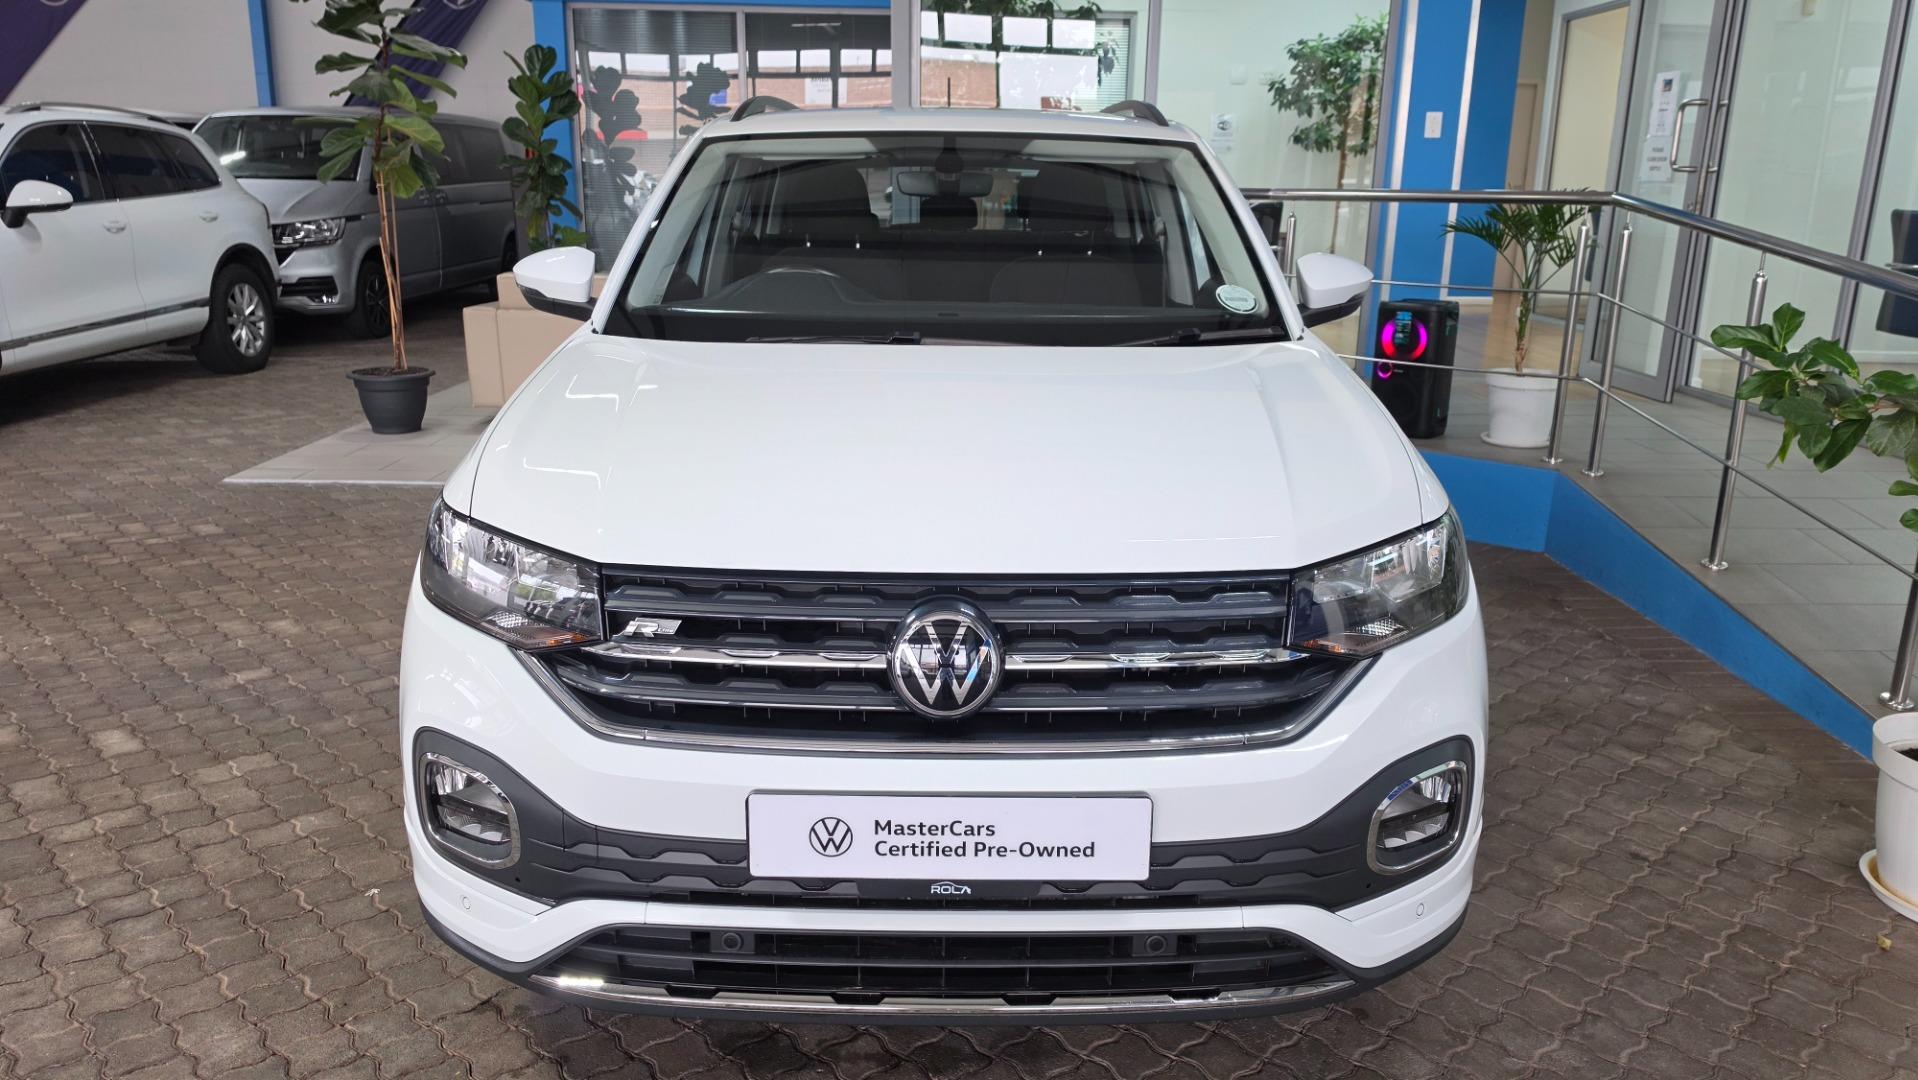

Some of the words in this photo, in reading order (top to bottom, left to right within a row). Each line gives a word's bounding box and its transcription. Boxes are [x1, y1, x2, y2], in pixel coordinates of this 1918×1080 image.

[874, 819, 996, 837] MasterCars
[874, 840, 967, 858] Certified
[974, 840, 1095, 858] Pre-Owned
[930, 885, 972, 895] ROLA
